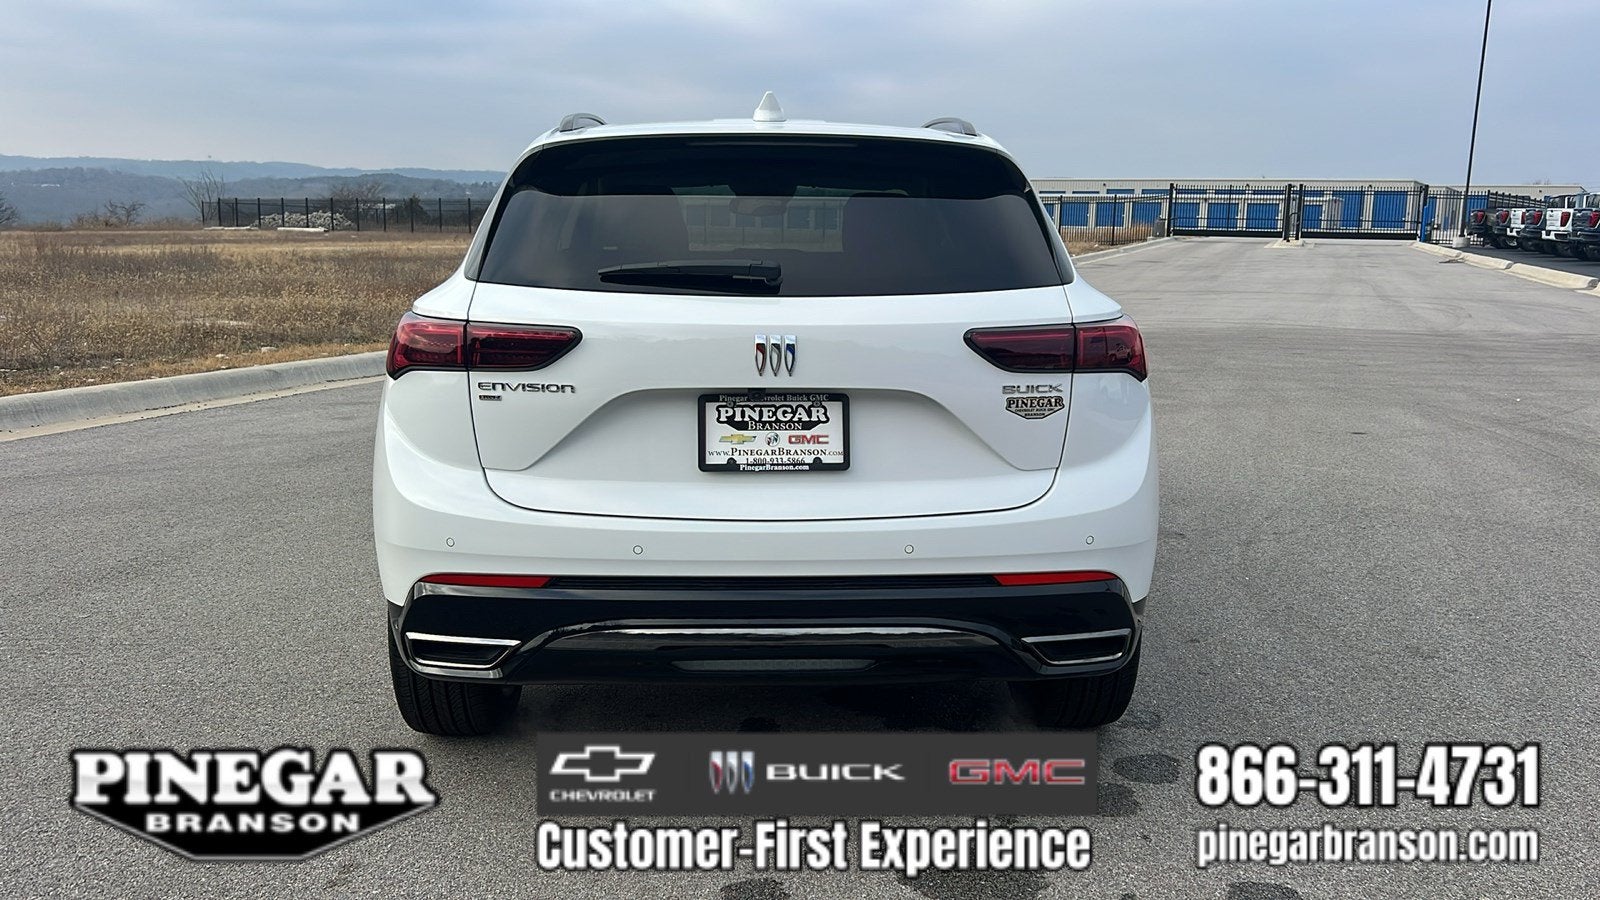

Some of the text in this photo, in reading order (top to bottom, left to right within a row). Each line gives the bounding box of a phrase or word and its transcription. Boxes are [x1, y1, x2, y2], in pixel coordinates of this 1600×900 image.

[478, 382, 576, 394] ENVISION
[1002, 384, 1063, 394] BUICK
[719, 394, 748, 402] Pinegar
[810, 393, 829, 401] GMC
[1007, 398, 1063, 408] PINEGAR
[718, 406, 828, 422] PINEGAR
[748, 421, 802, 430] BRANSON
[788, 434, 829, 445] GMC
[739, 464, 810, 472] PinegarBranson.com
